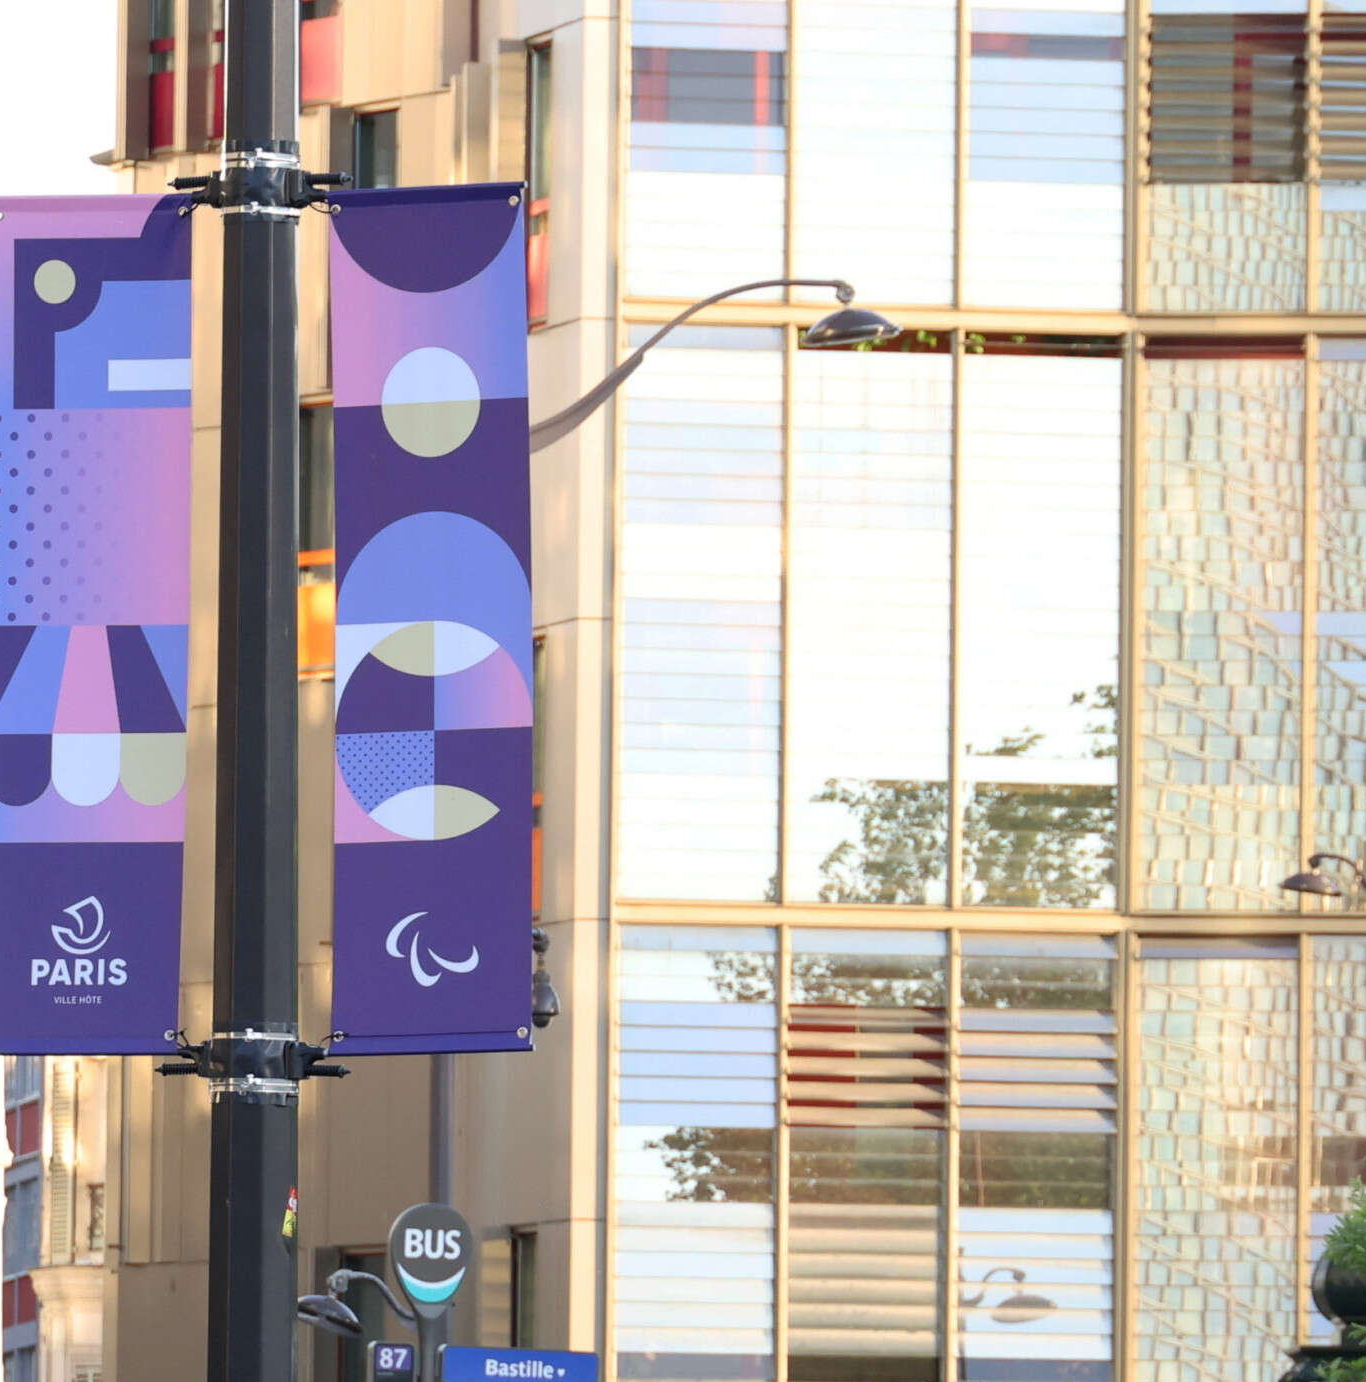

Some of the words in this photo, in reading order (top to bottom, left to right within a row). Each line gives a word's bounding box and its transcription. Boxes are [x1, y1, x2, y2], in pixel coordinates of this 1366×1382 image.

[30, 957, 128, 986] PARIS
[54, 995, 77, 1004] VILLE
[80, 993, 102, 1004] HÔTE
[405, 1228, 461, 1260] BUS
[379, 1348, 407, 1369] 87
[485, 1358, 554, 1381] Bastille
